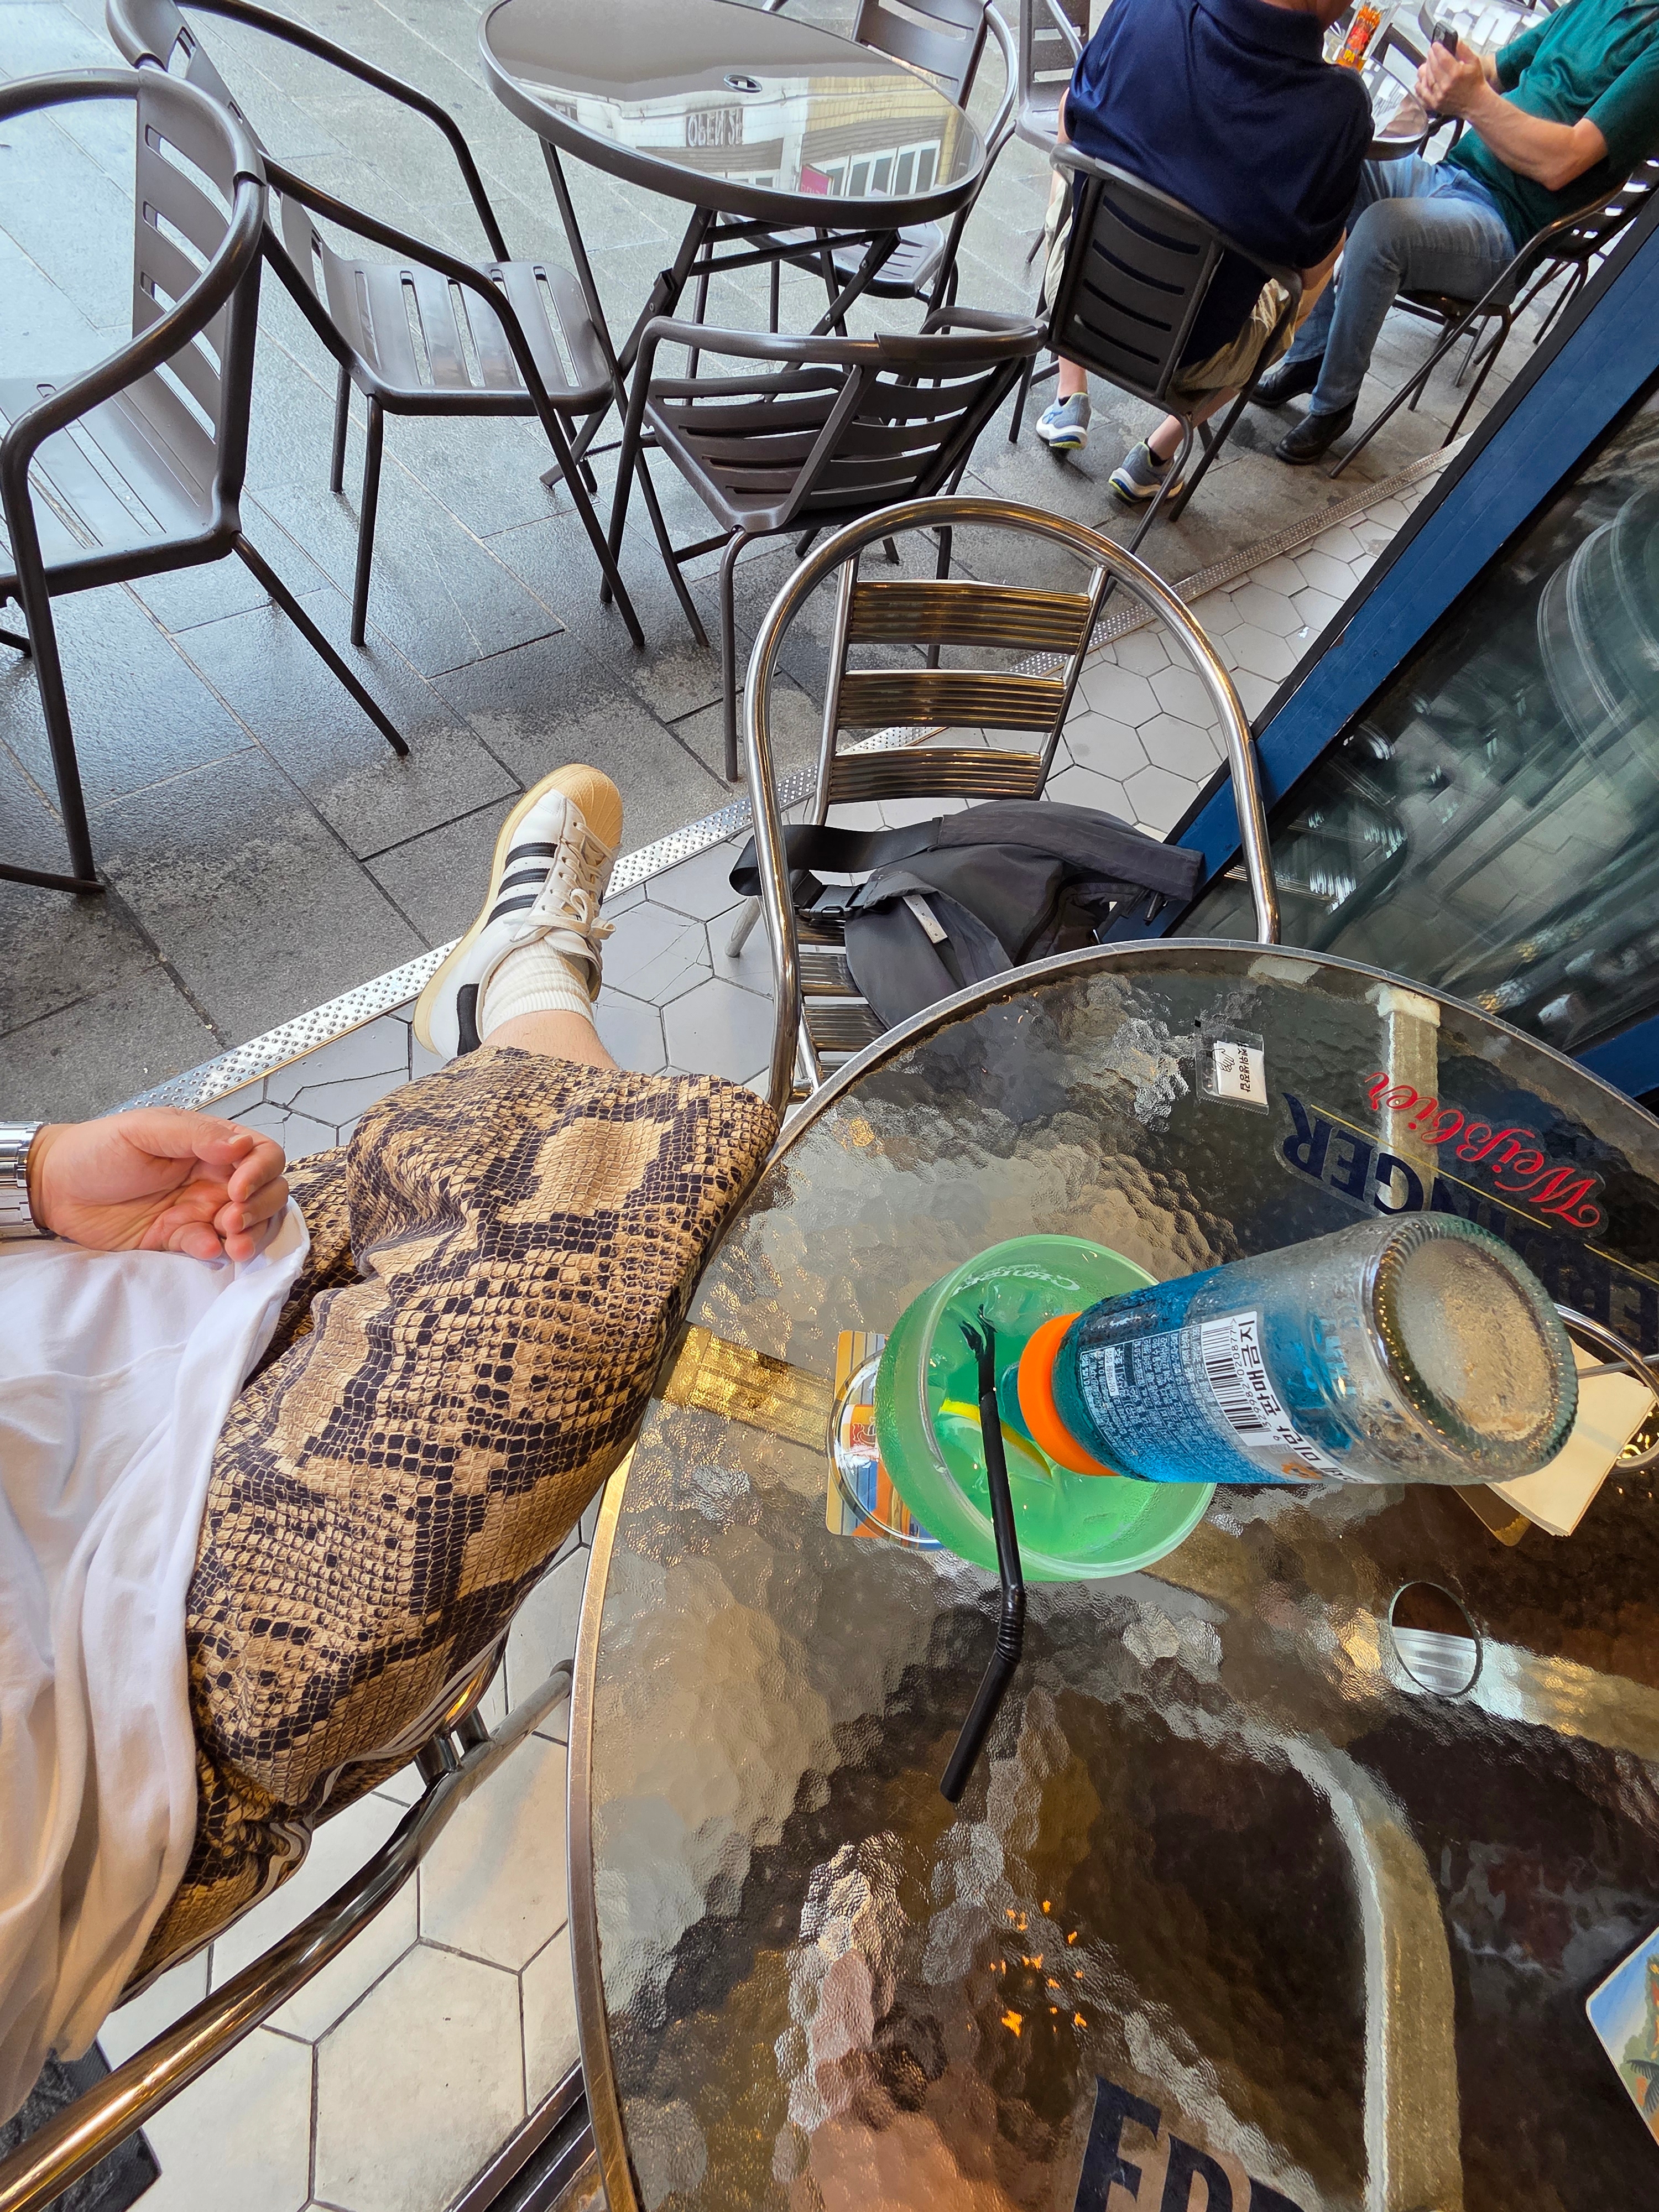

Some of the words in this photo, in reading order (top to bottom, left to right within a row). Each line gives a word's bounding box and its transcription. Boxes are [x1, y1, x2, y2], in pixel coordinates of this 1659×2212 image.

[1343, 48, 1355, 64] IPA
[1364, 1071, 1601, 1228] Weißbier
[1114, 1348, 1123, 1364] 호주
[1230, 1329, 1245, 1376] 020877
[1238, 1320, 1282, 1416] 판매금지
[1243, 1384, 1272, 1427] 329982
[1276, 1426, 1321, 1460] 미만
